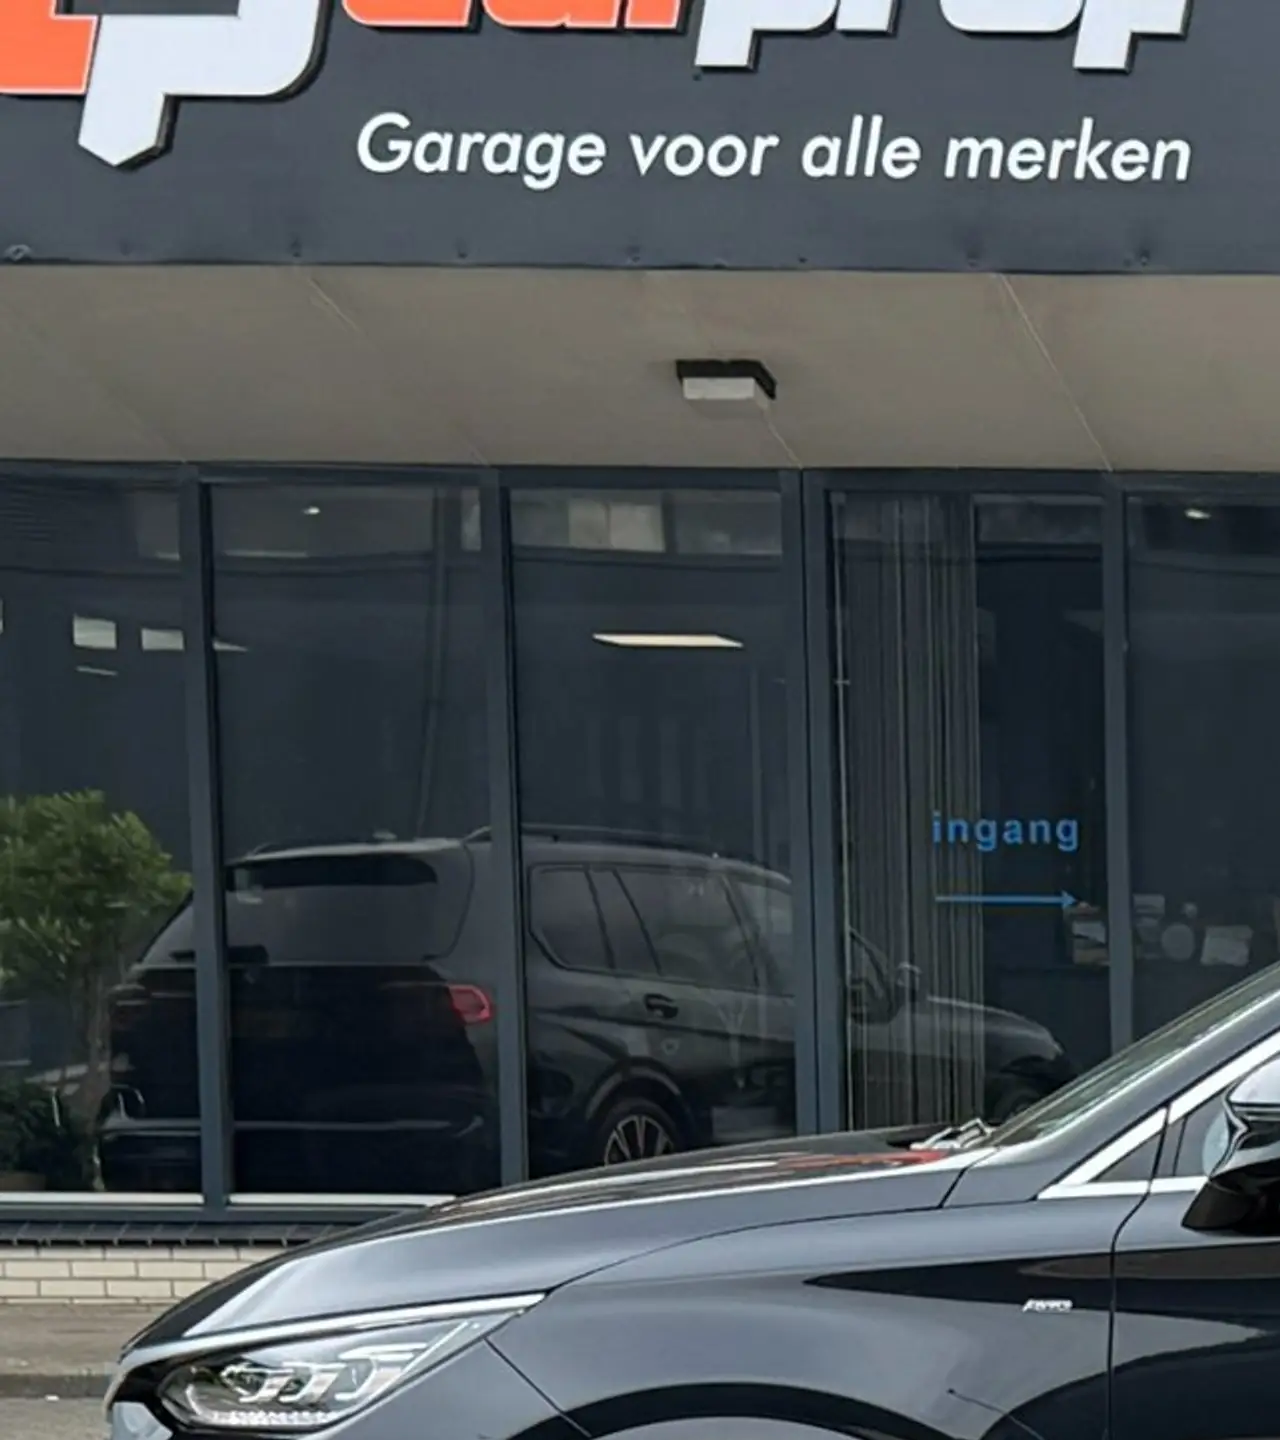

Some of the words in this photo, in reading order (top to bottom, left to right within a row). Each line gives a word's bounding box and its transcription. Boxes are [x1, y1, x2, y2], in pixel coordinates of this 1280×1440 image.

[357, 112, 607, 190] Garage
[629, 134, 780, 177] voor
[801, 114, 921, 179] alle
[944, 117, 1191, 181] merken
[931, 810, 1079, 851] ingang
